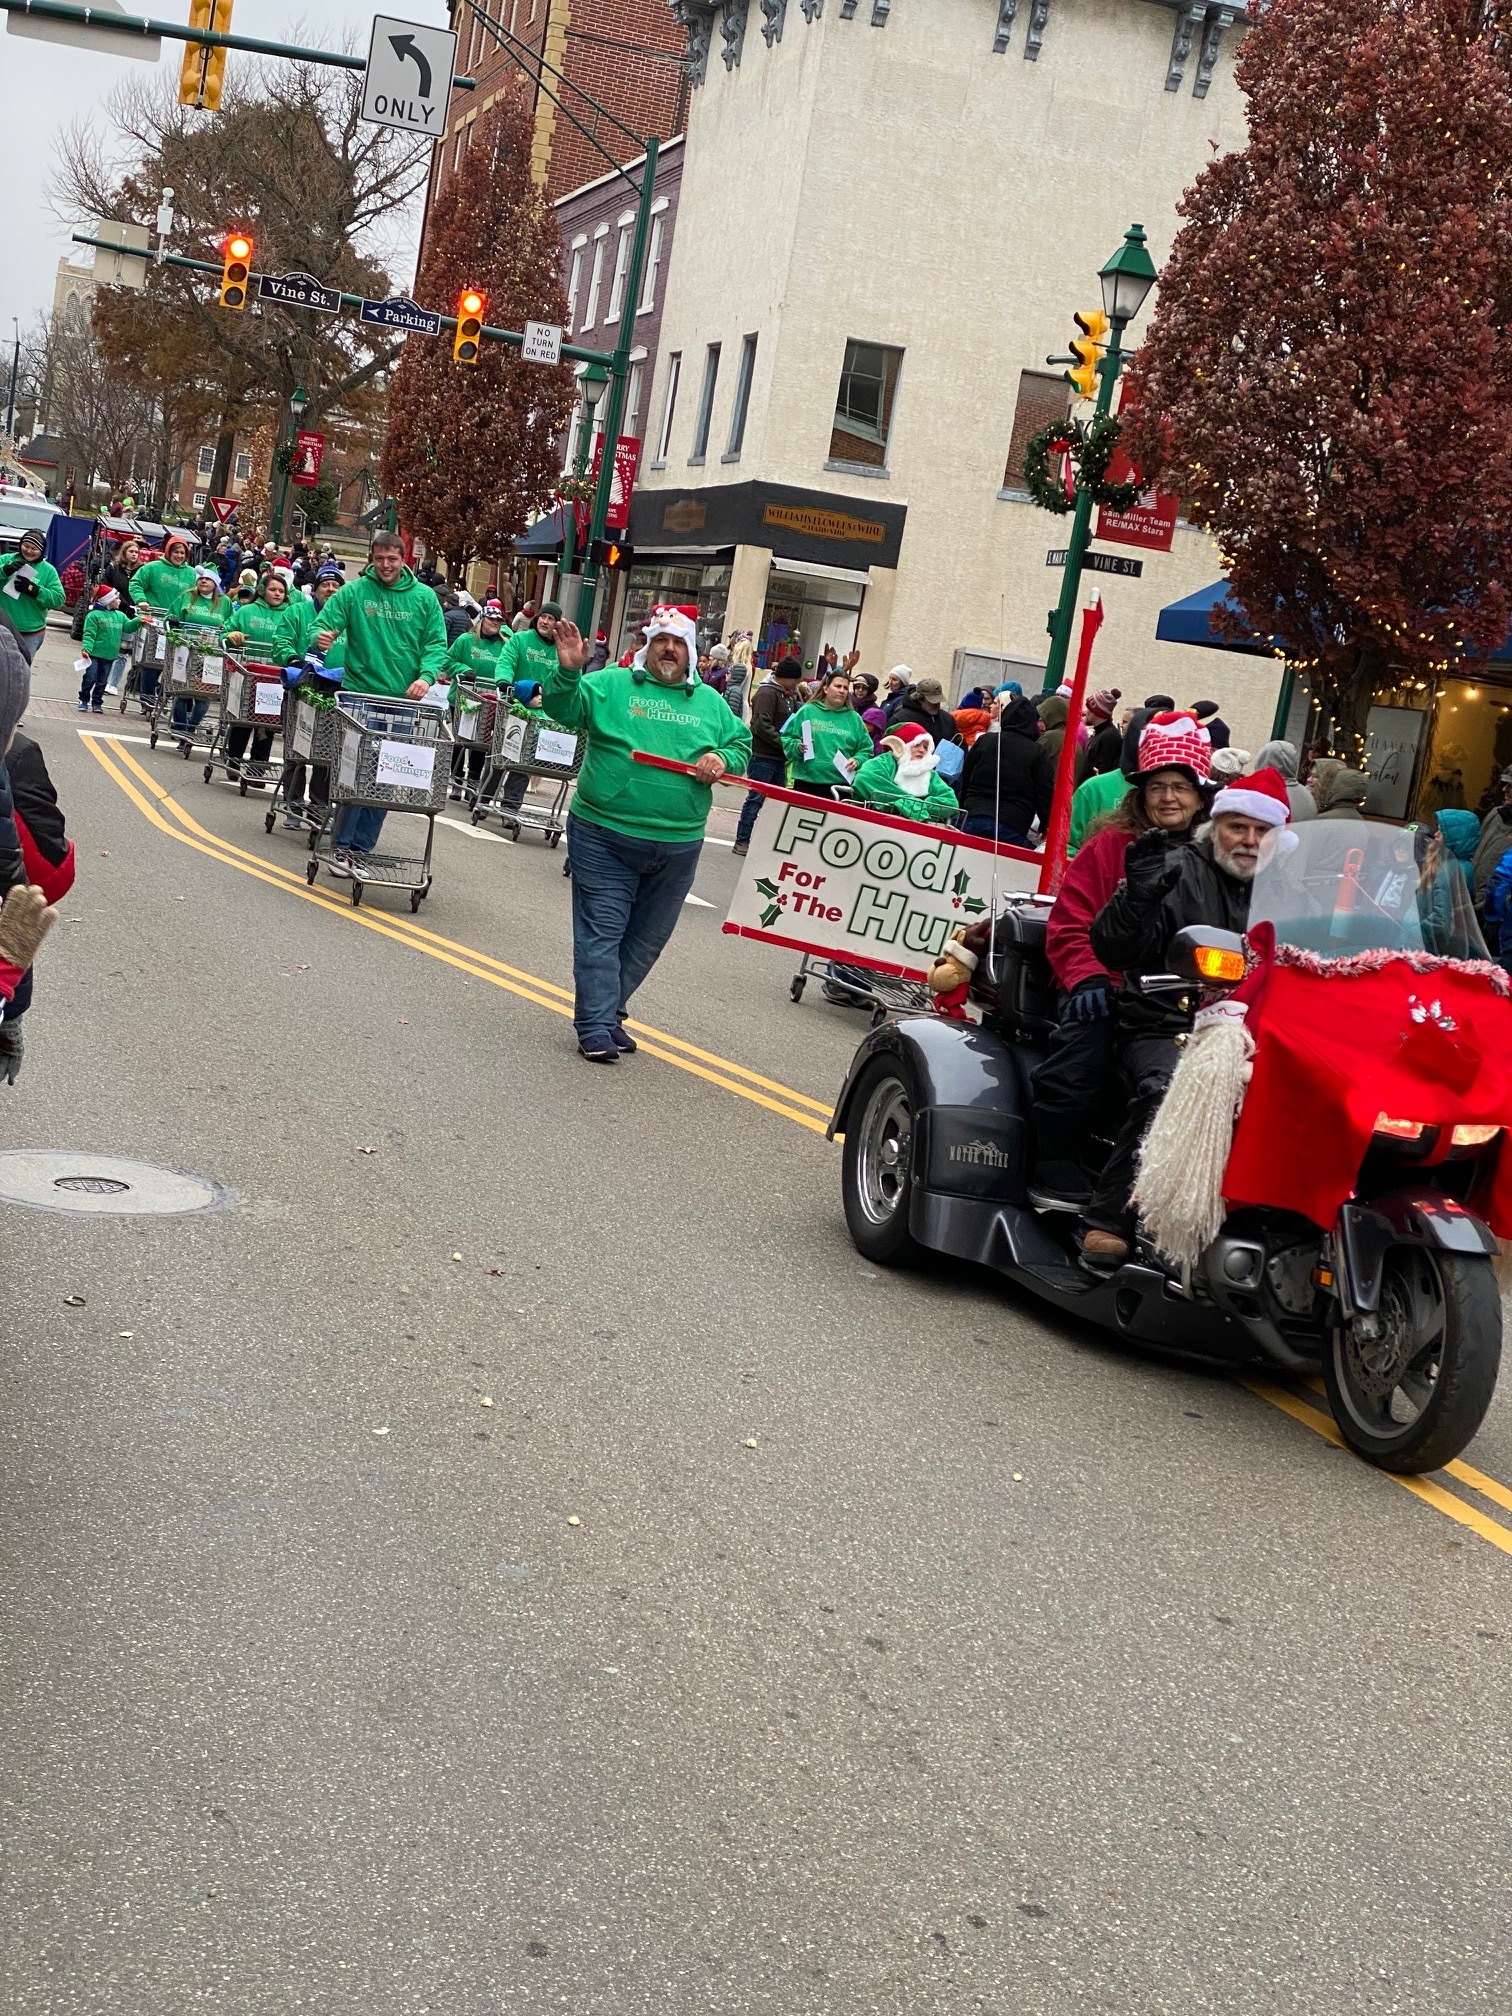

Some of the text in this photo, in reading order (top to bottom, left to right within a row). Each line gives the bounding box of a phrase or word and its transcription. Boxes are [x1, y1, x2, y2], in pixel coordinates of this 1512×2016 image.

[374, 94, 436, 125] ONLY
[269, 281, 331, 306] Vine St.
[384, 308, 436, 331] Parking
[537, 327, 551, 337] NO
[532, 337, 554, 349] TURN
[525, 347, 556, 360] ON RED
[1102, 509, 1171, 528] Sam Miller Team
[1105, 519, 1164, 537] RE/MAX Stars
[1094, 555, 1136, 575] VINE ST.
[628, 695, 667, 710] Food
[647, 707, 701, 728] Hungry
[381, 752, 408, 765] Food
[393, 763, 432, 778] Hungry
[773, 804, 956, 894] Food
[778, 861, 827, 890] For
[792, 891, 843, 923] The
